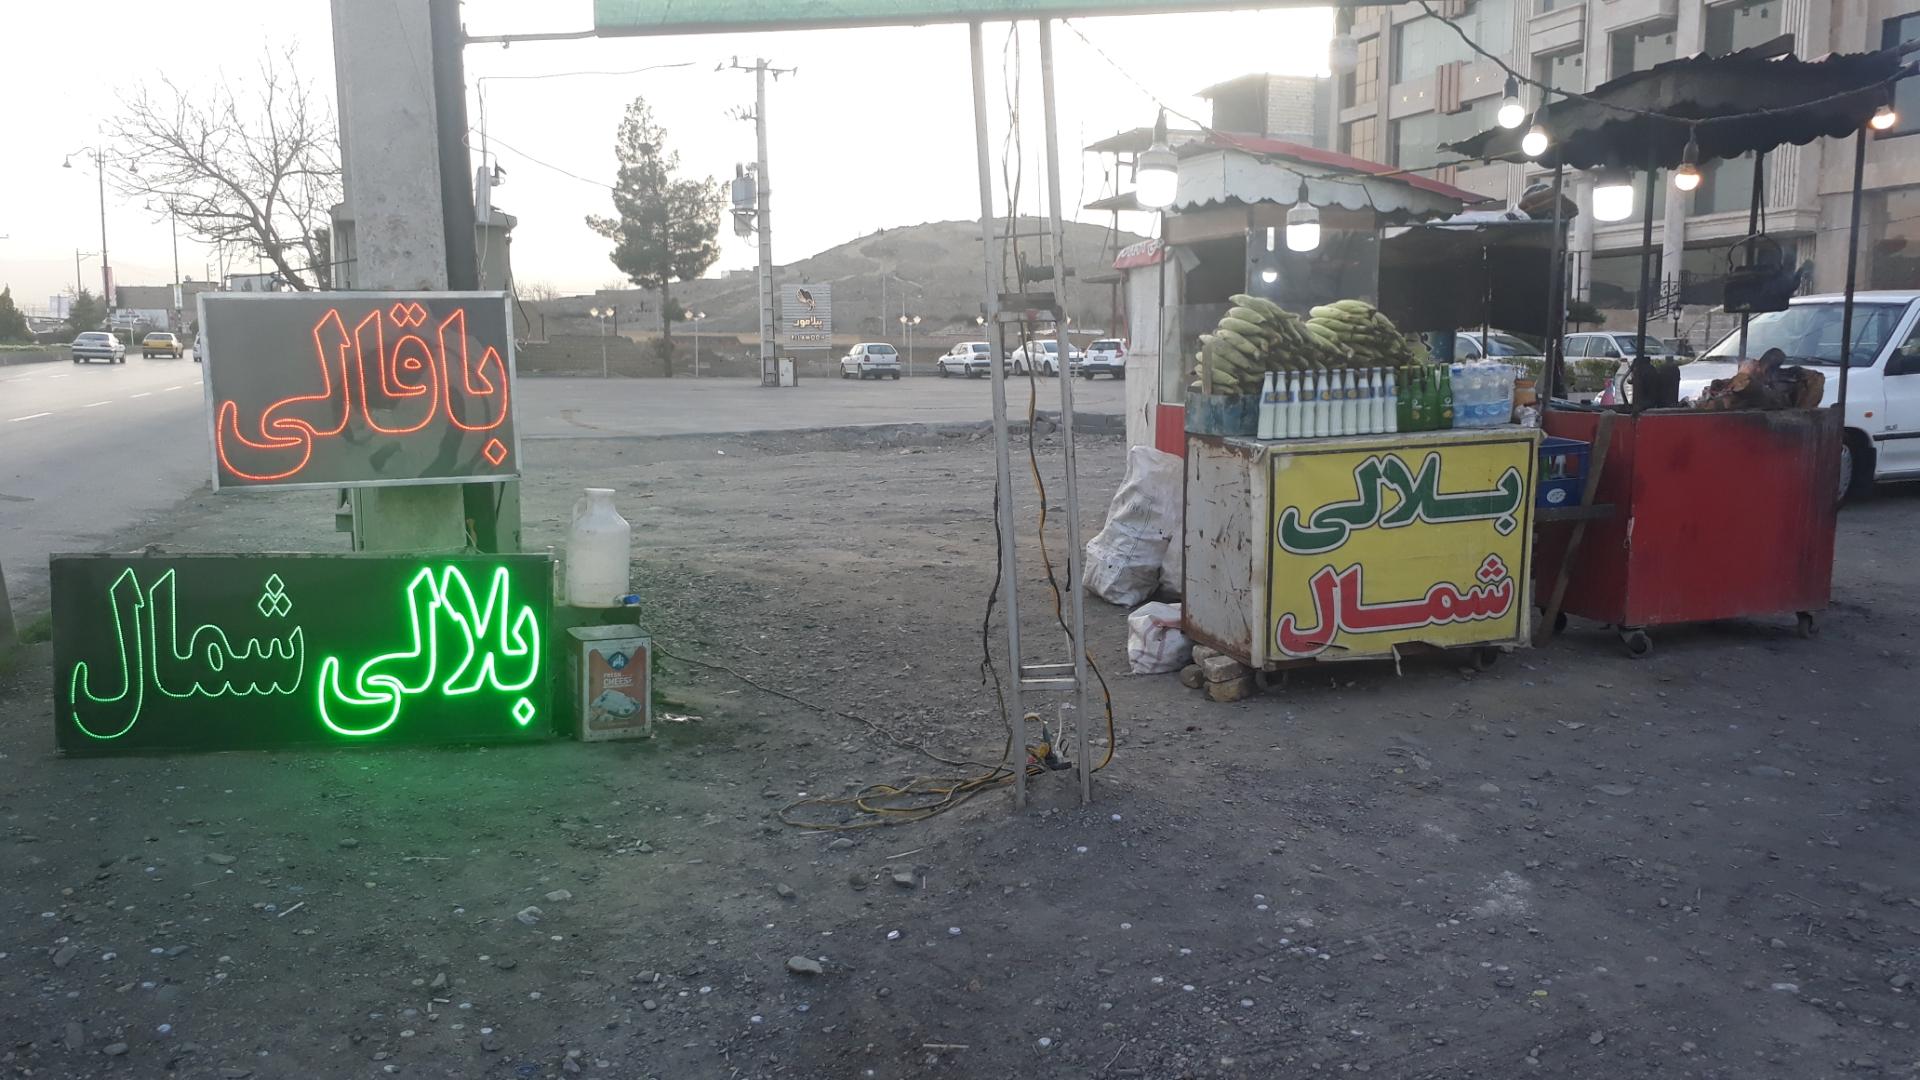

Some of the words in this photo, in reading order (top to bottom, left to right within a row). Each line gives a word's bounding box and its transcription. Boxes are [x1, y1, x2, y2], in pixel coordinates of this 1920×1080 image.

[218, 302, 508, 480] باقالی
[1278, 451, 1522, 554] بلالی
[72, 567, 304, 738] شمال
[318, 565, 541, 736] بلالی
[1276, 553, 1514, 657] شمال
